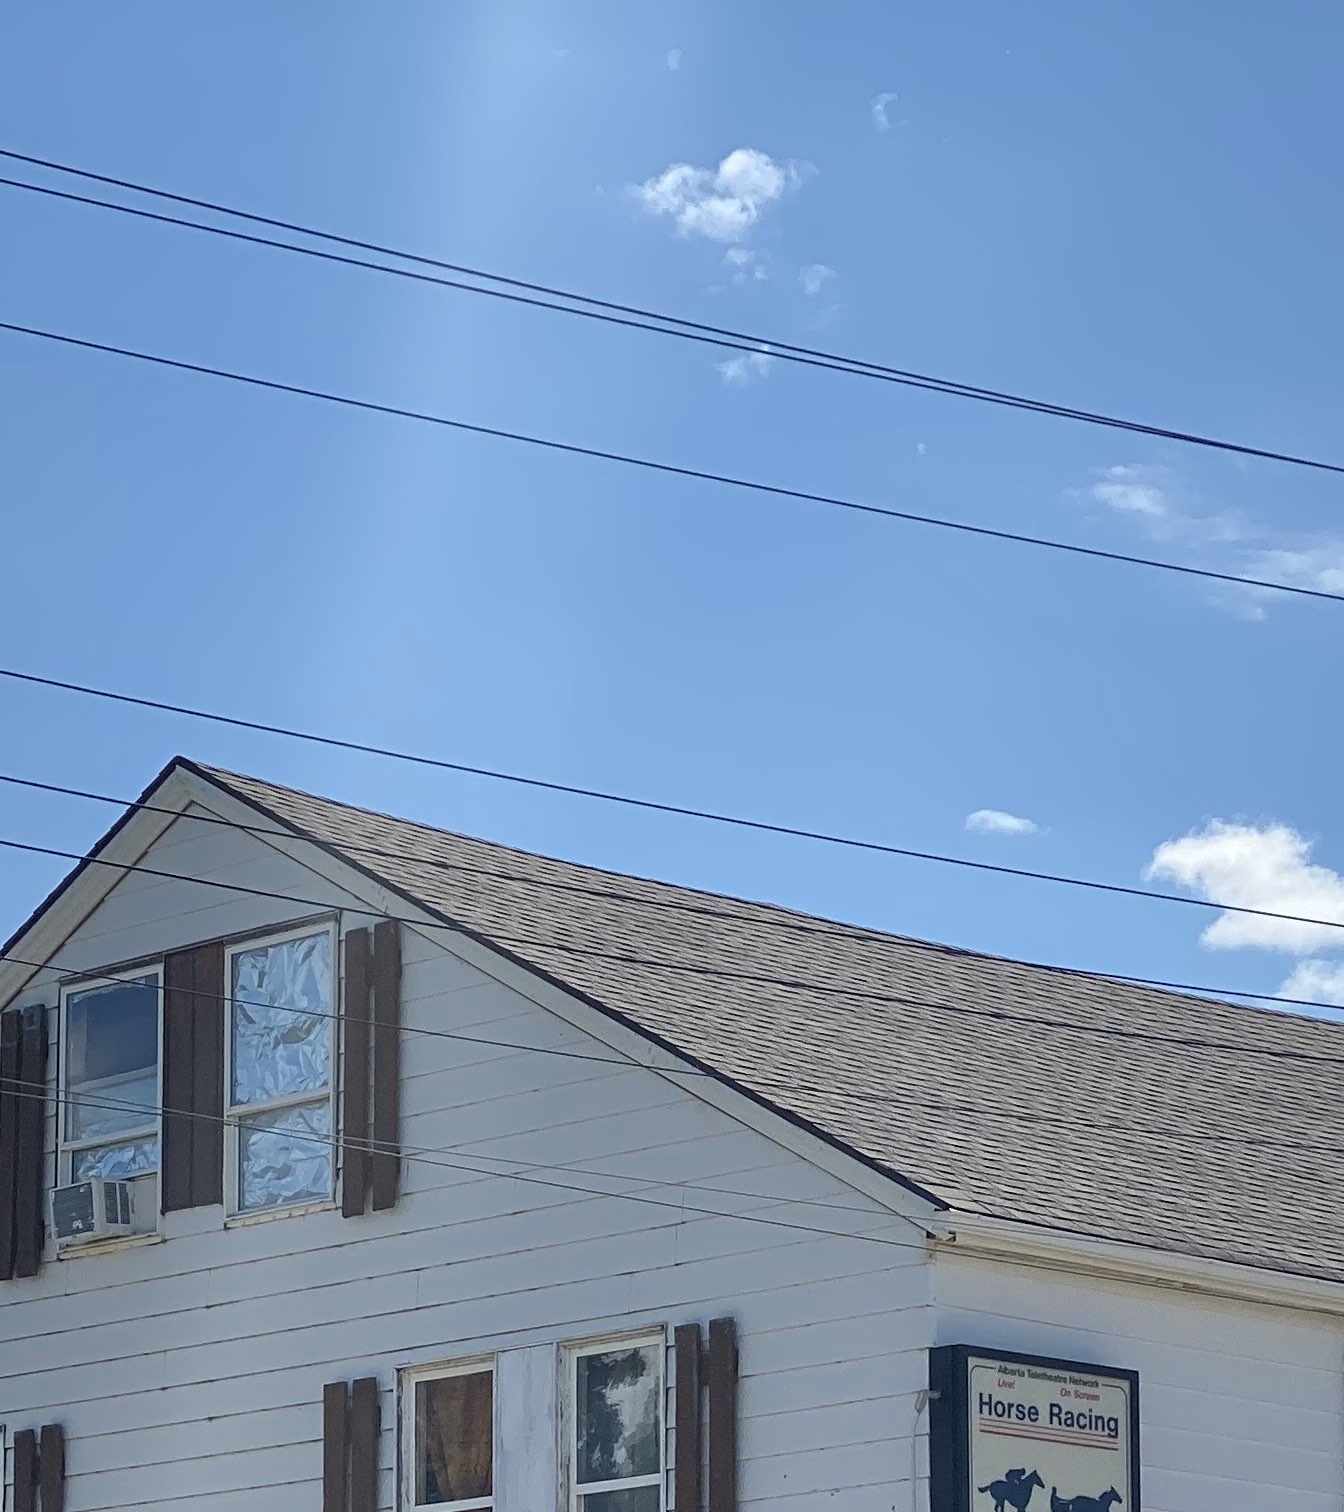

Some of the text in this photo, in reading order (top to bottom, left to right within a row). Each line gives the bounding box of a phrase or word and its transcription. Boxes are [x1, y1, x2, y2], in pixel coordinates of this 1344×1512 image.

[1060, 1388, 1071, 1398] On
[979, 1392, 1119, 1438] Horse Racing
